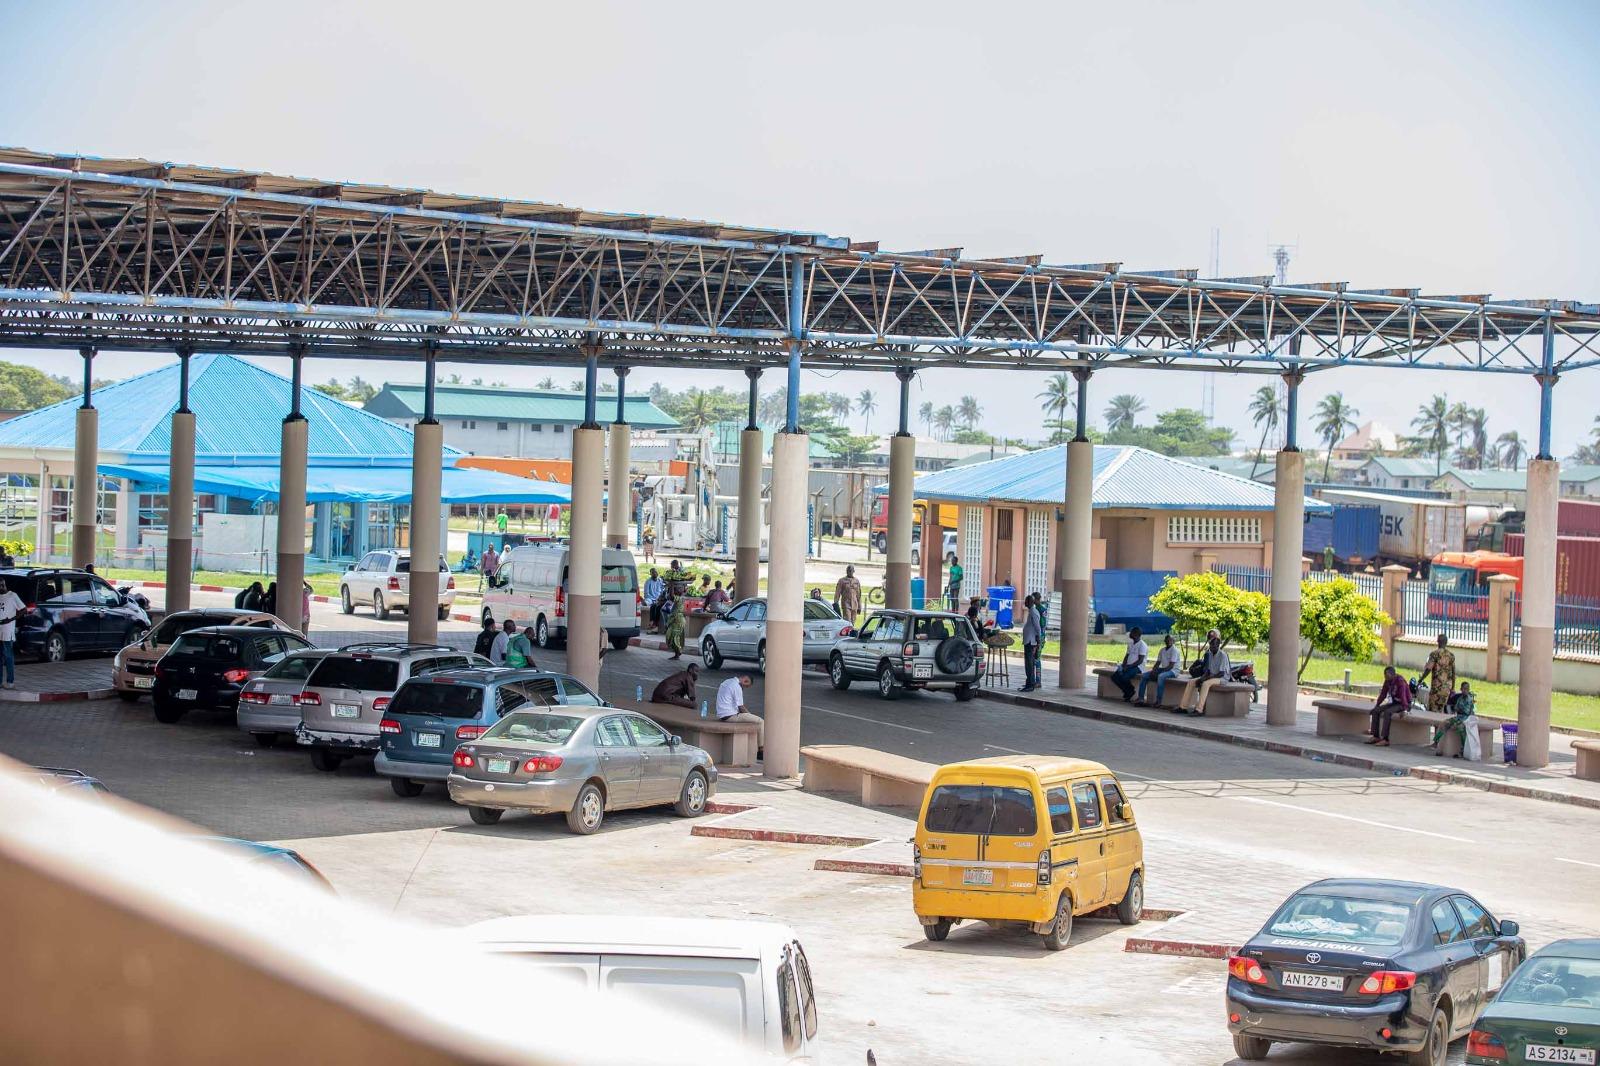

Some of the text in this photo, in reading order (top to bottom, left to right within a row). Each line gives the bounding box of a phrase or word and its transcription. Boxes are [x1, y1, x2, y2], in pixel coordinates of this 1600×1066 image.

[1272, 938, 1366, 953] EDUCATIONAL
[1284, 972, 1328, 988] AN1278
[1528, 1046, 1546, 1059] AS
[1548, 1048, 1576, 1062] 2134
